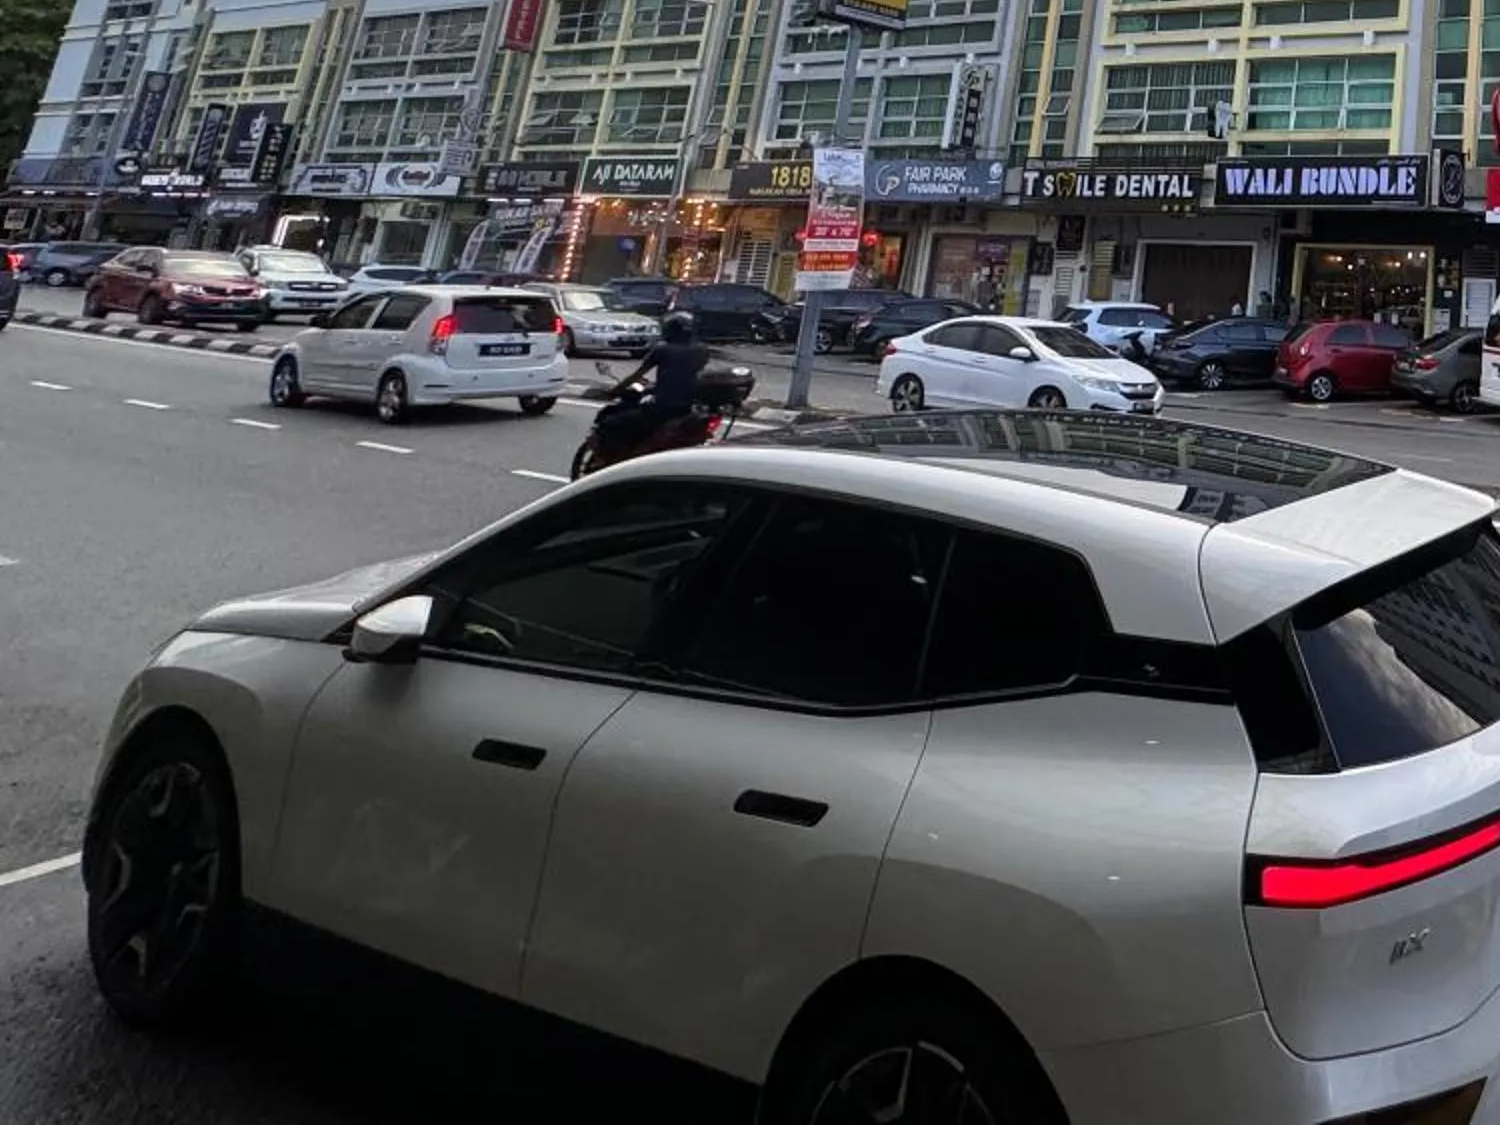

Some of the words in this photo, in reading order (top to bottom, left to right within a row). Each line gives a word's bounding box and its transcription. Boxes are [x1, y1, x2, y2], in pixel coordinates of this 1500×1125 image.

[614, 164, 675, 180] DATARAN
[771, 166, 811, 187] 1818
[933, 166, 966, 182] PARK
[1225, 167, 1292, 195] WALI
[1300, 166, 1416, 195] BUNDLE
[1115, 174, 1193, 197] DENTAL
